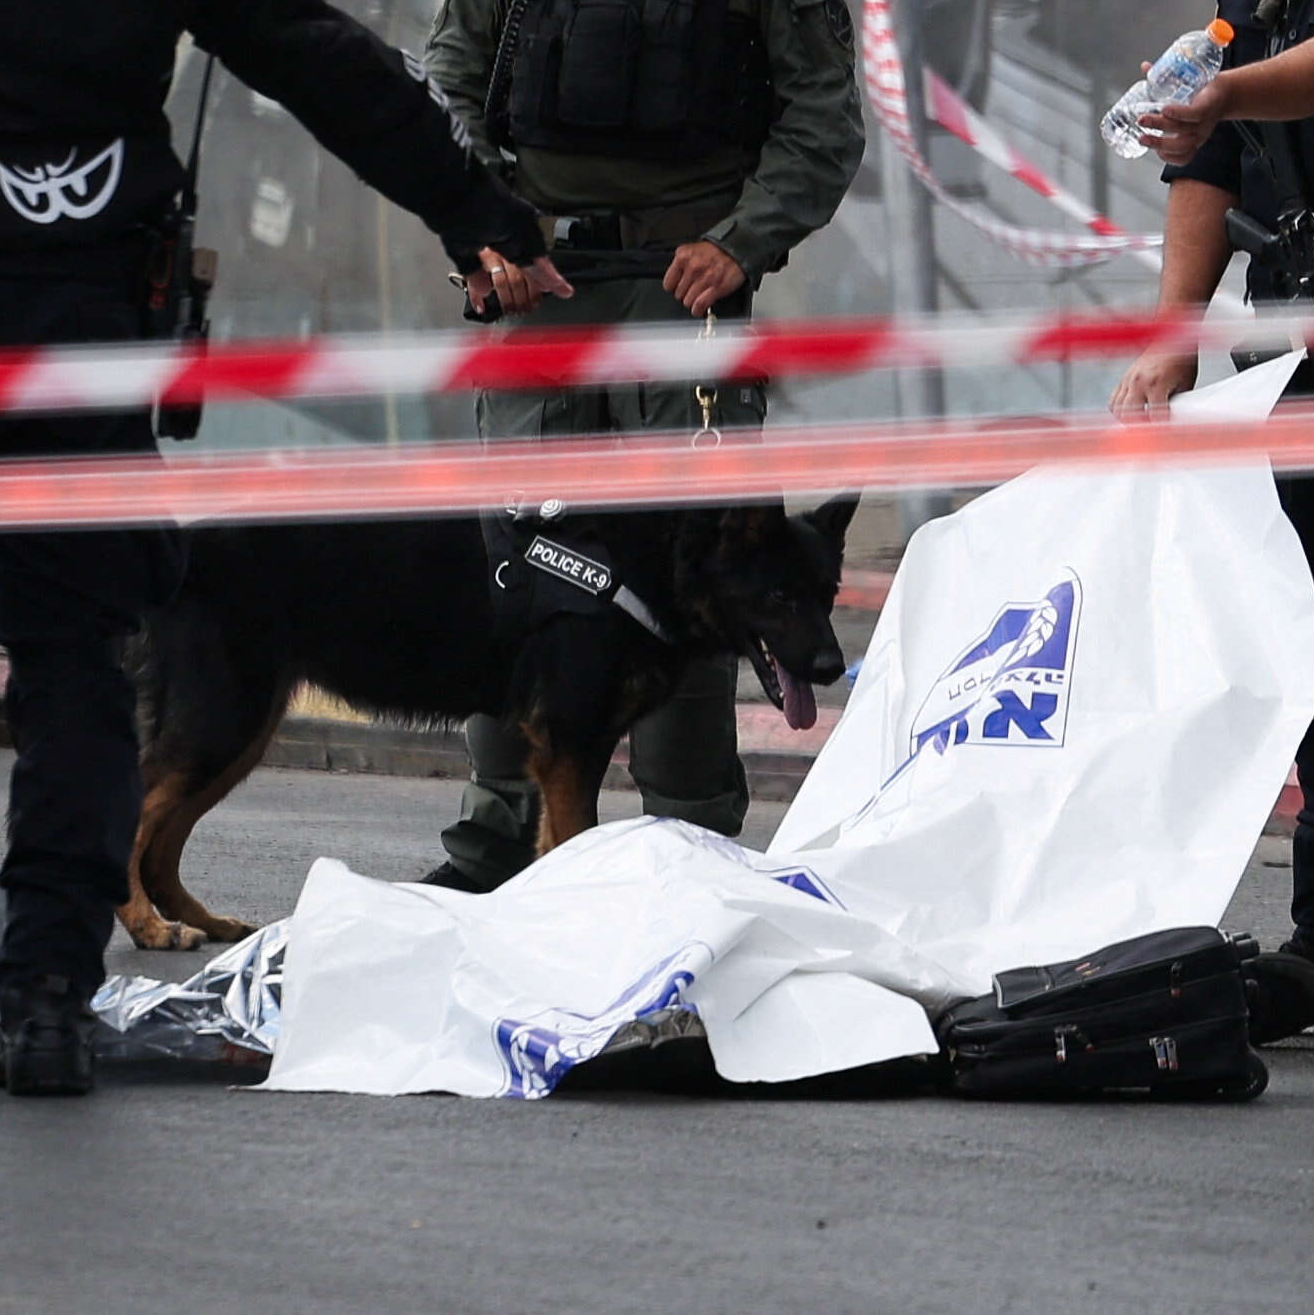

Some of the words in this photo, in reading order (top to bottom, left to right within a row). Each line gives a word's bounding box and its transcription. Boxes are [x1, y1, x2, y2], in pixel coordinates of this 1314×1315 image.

[531, 543, 584, 577] POLICE
[582, 568, 607, 589] K-9
[993, 671, 1065, 686] צלה
